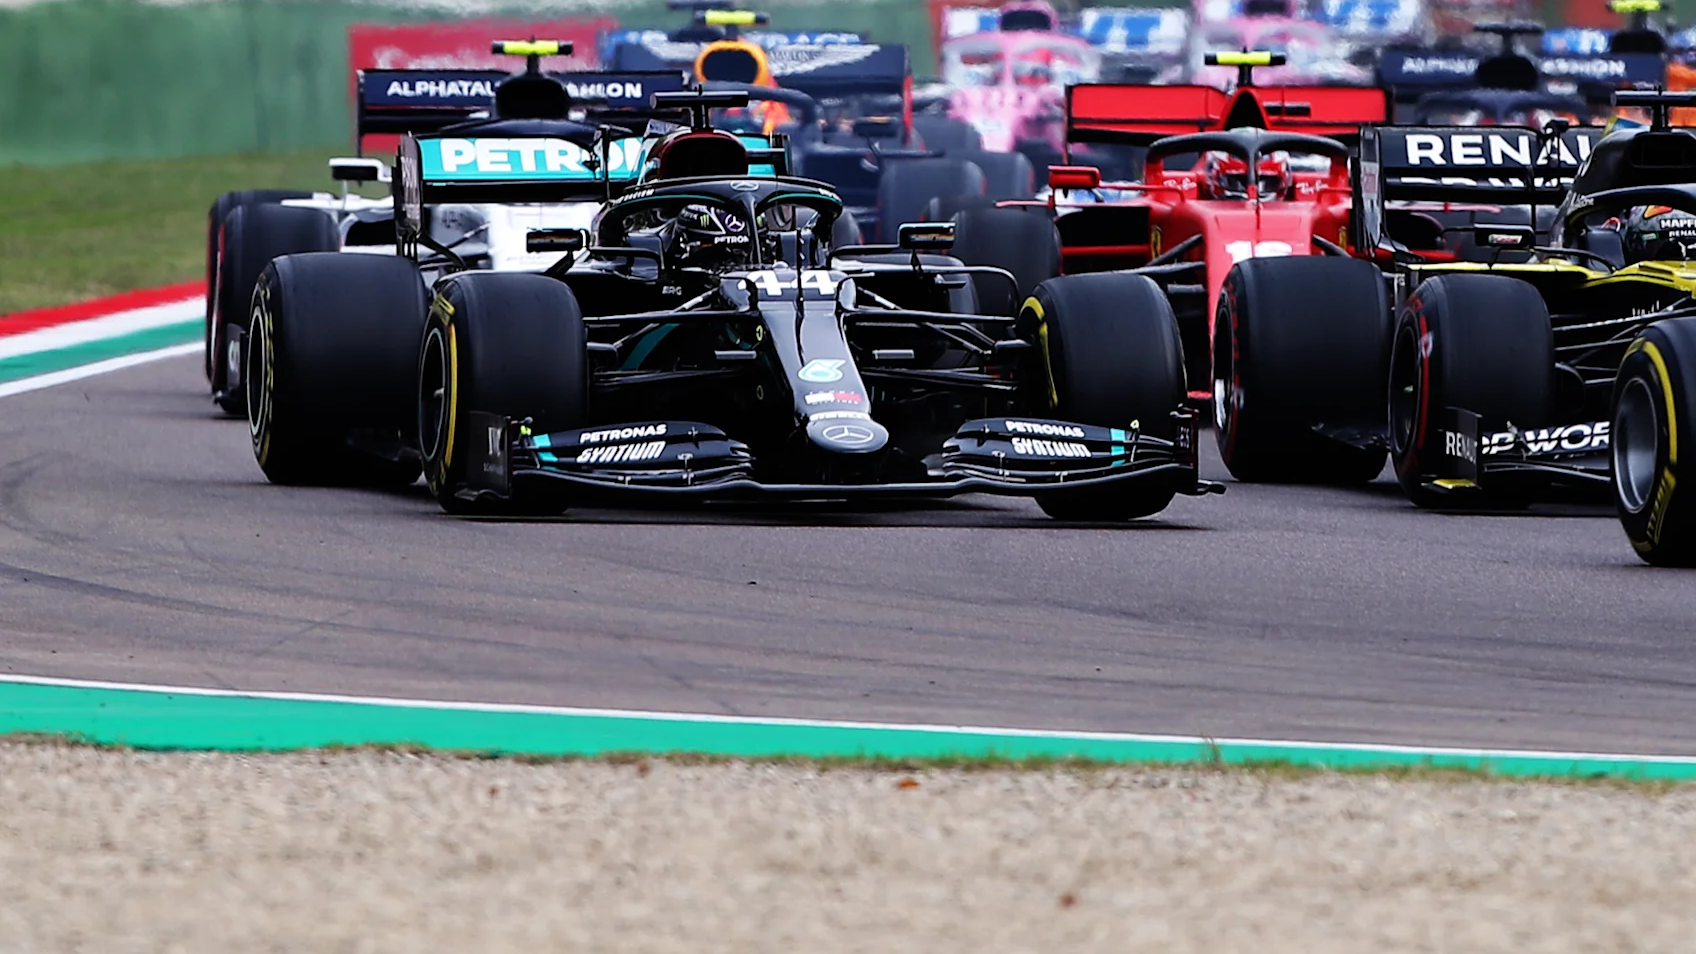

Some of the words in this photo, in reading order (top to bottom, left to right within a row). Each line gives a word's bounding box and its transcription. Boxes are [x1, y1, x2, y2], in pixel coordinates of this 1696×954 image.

[737, 270, 839, 296] 44
[579, 423, 668, 444] PETRONAS
[1005, 420, 1085, 438] PETRONAS
[576, 440, 667, 464] SYNTIUM
[1010, 437, 1093, 458] SYNTIUM
